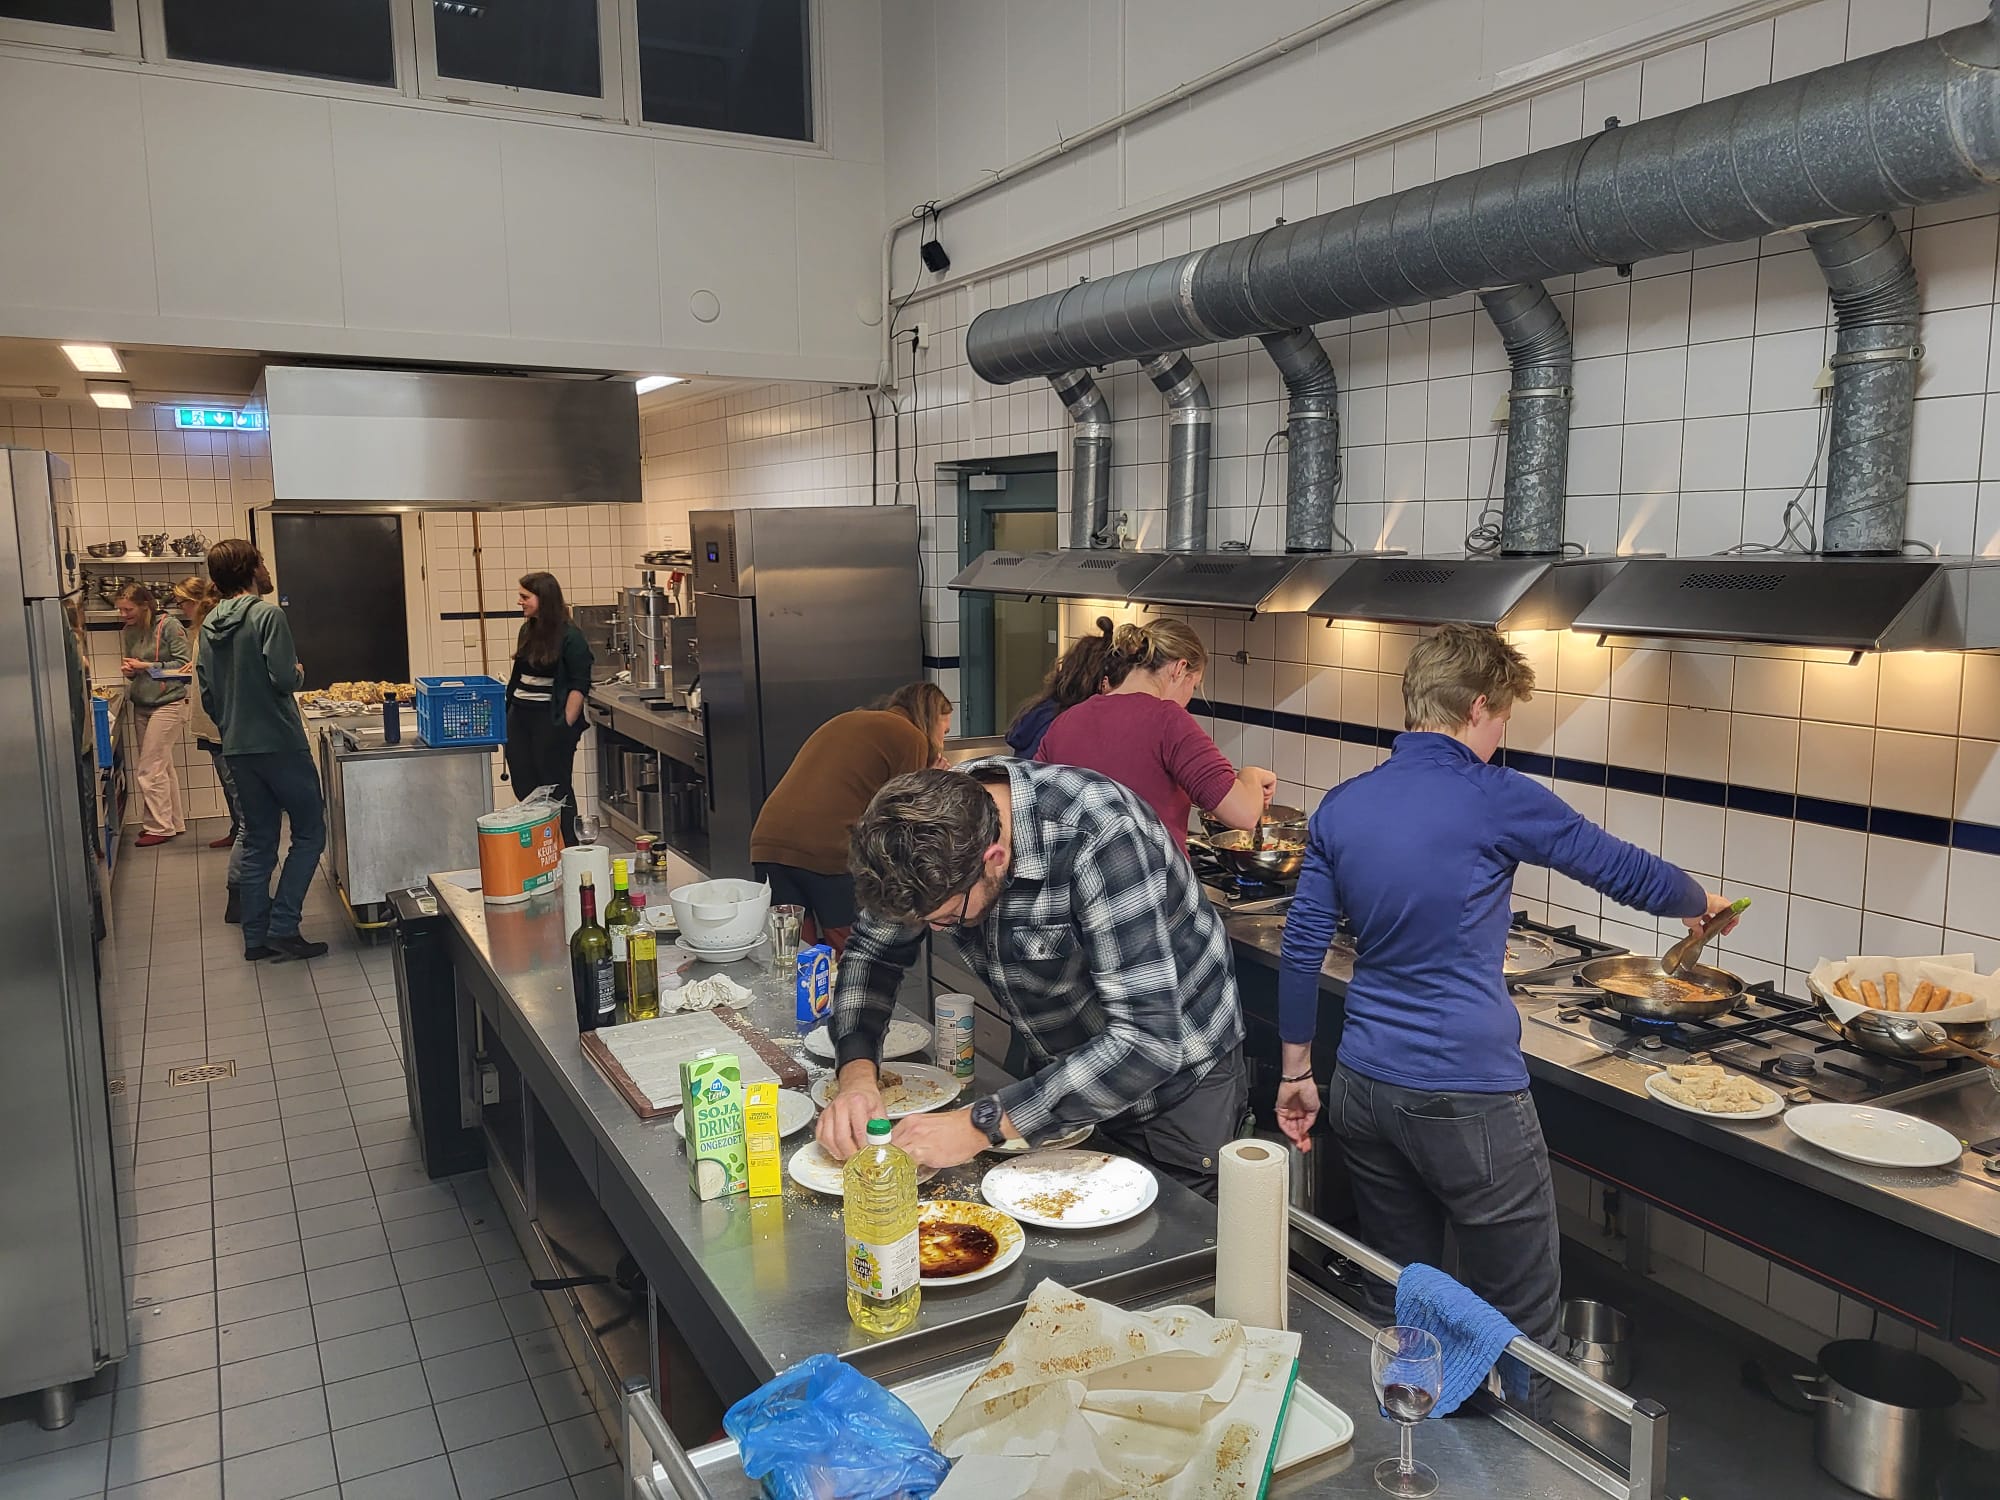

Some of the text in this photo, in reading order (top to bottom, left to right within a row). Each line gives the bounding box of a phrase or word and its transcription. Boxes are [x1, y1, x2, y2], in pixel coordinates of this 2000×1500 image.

[698, 1102, 740, 1121] SOJA
[699, 1114, 741, 1139] DRINK
[700, 1134, 743, 1152] ONGEZOET
